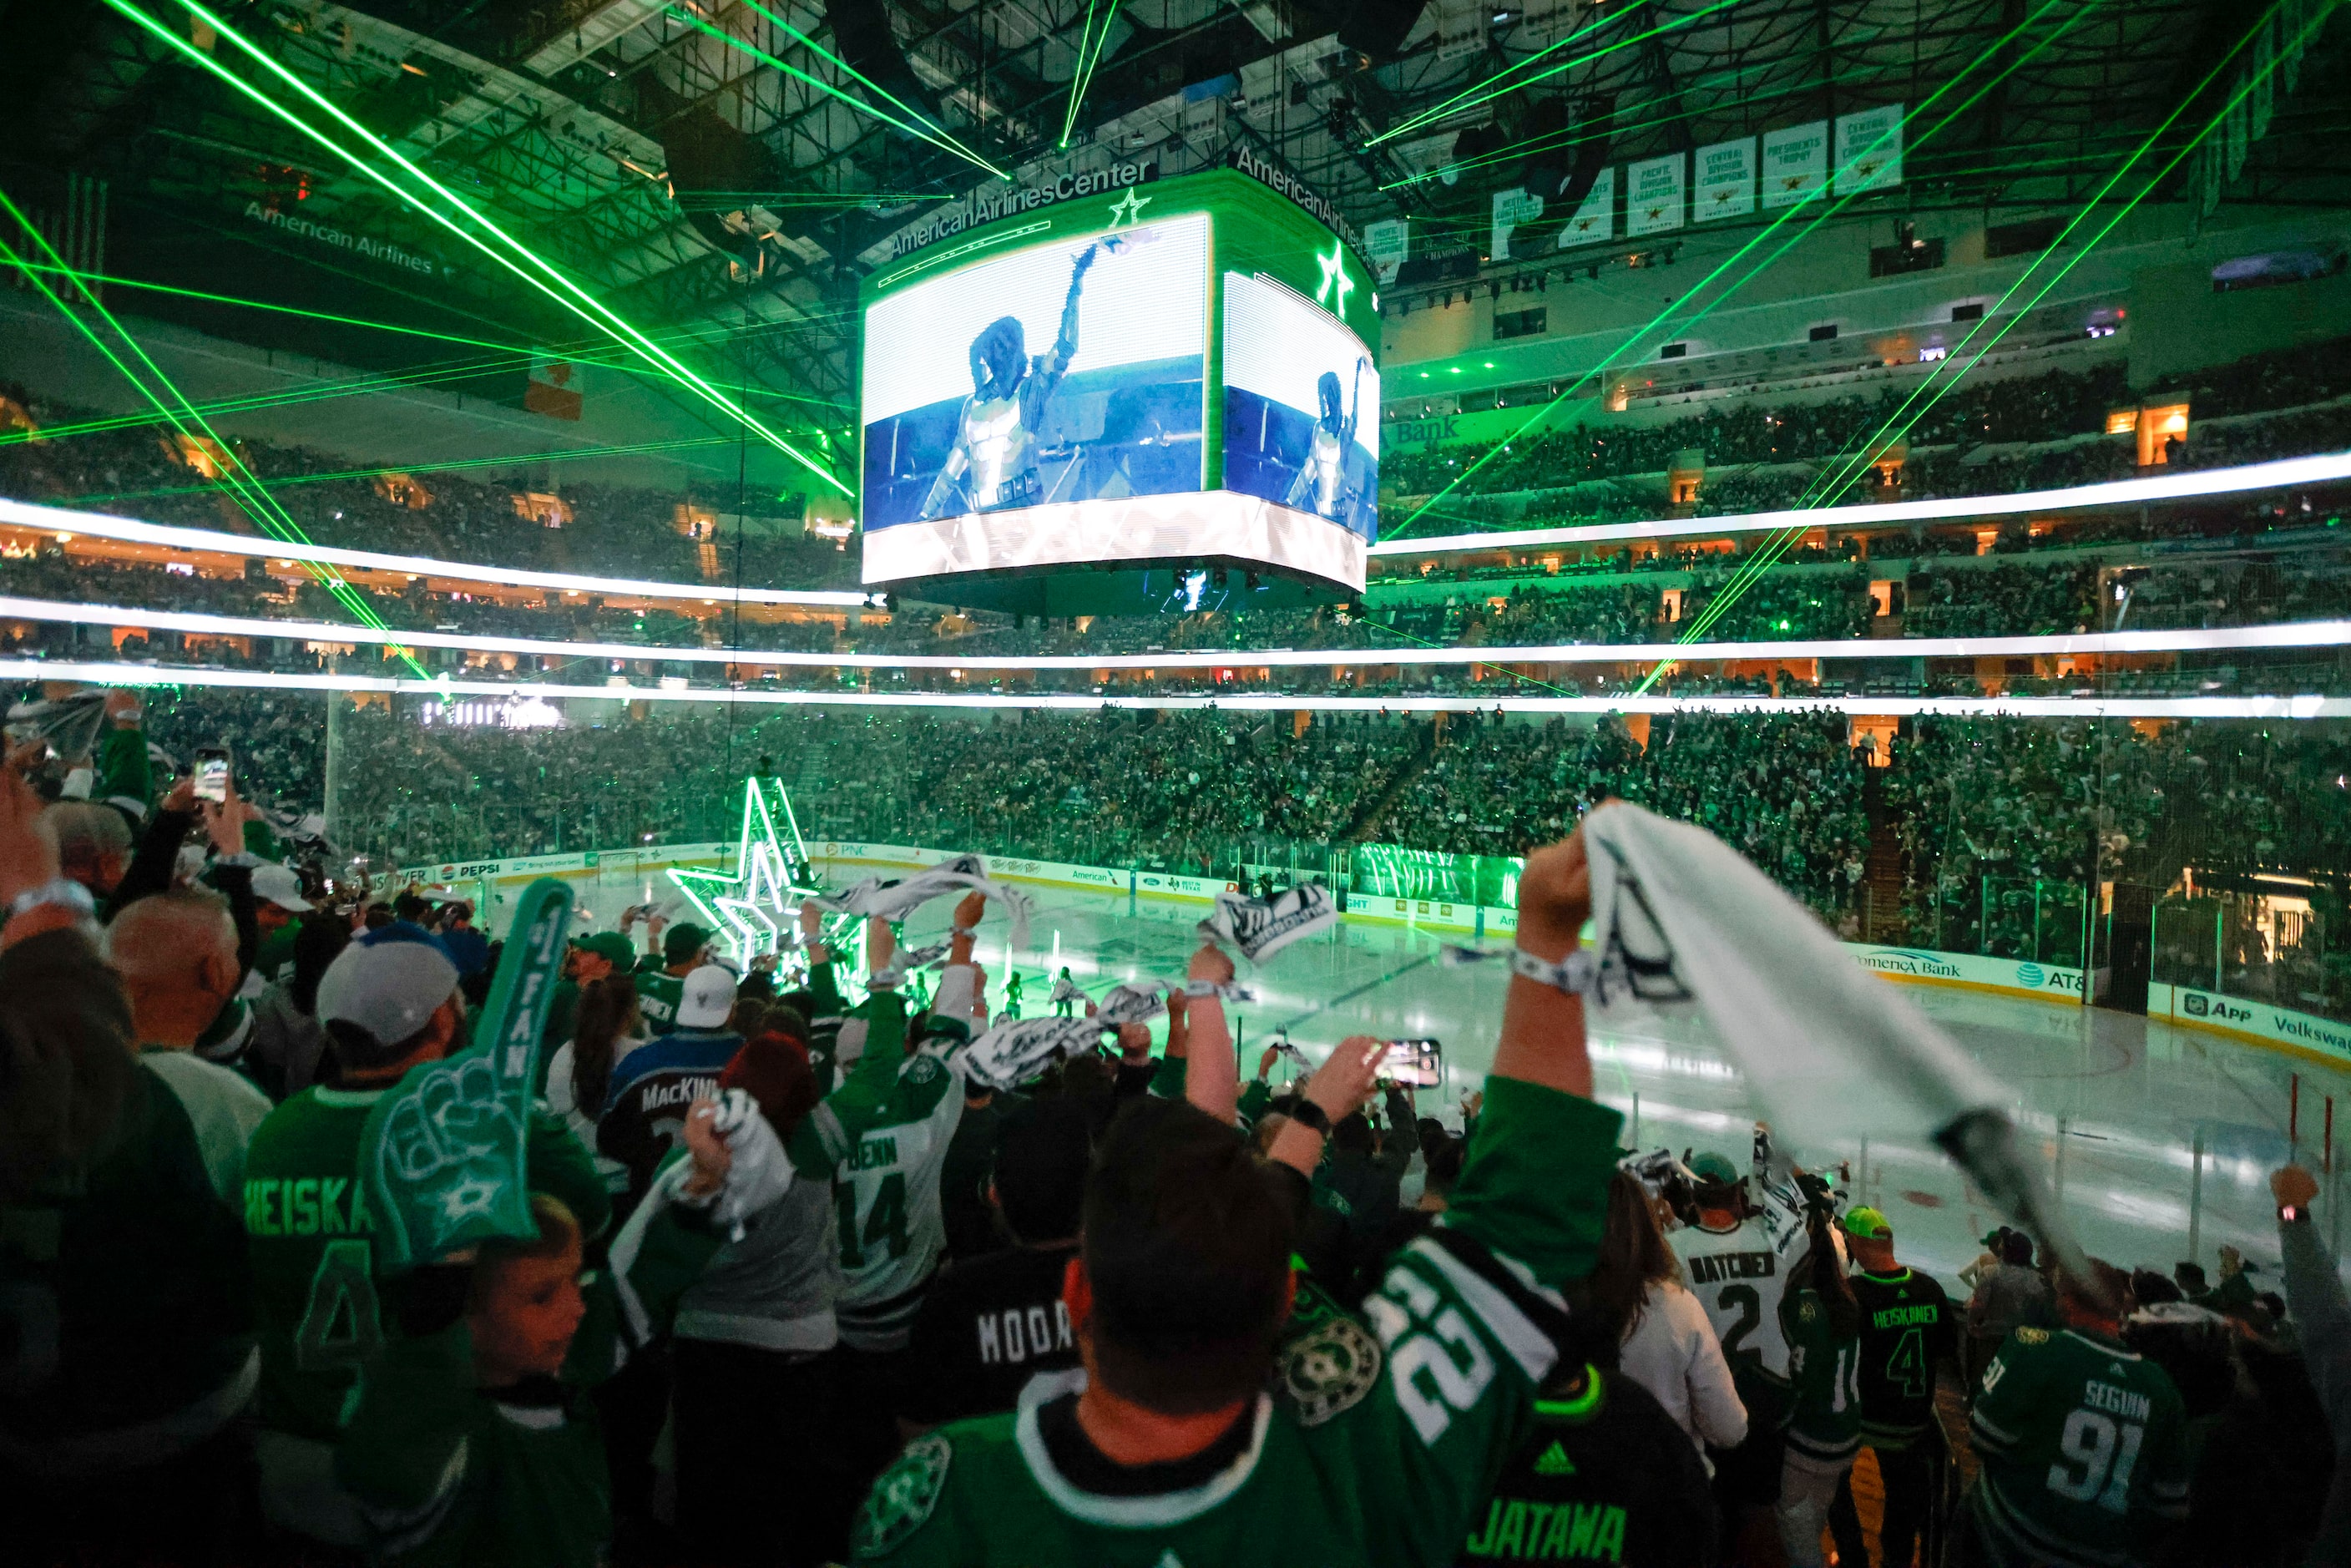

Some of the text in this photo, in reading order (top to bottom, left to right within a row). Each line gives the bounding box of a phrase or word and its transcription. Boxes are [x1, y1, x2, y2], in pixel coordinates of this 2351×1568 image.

[245, 201, 432, 274] American Airlines
[1425, 245, 1470, 260] CHAMPIONS
[1397, 417, 1459, 443] Bank
[460, 864, 499, 877] PEPSI
[842, 845, 868, 856] PNC
[1073, 870, 1107, 882] American
[1923, 963, 1960, 977] Bank
[837, 1171, 912, 1269] 14
[1718, 1284, 1762, 1369] 2
[1887, 1328, 1925, 1397] 4
[2084, 1380, 2151, 1423] SEGUIN
[2047, 1408, 2144, 1515] 91
[1466, 1497, 1627, 1562] JATAWA
